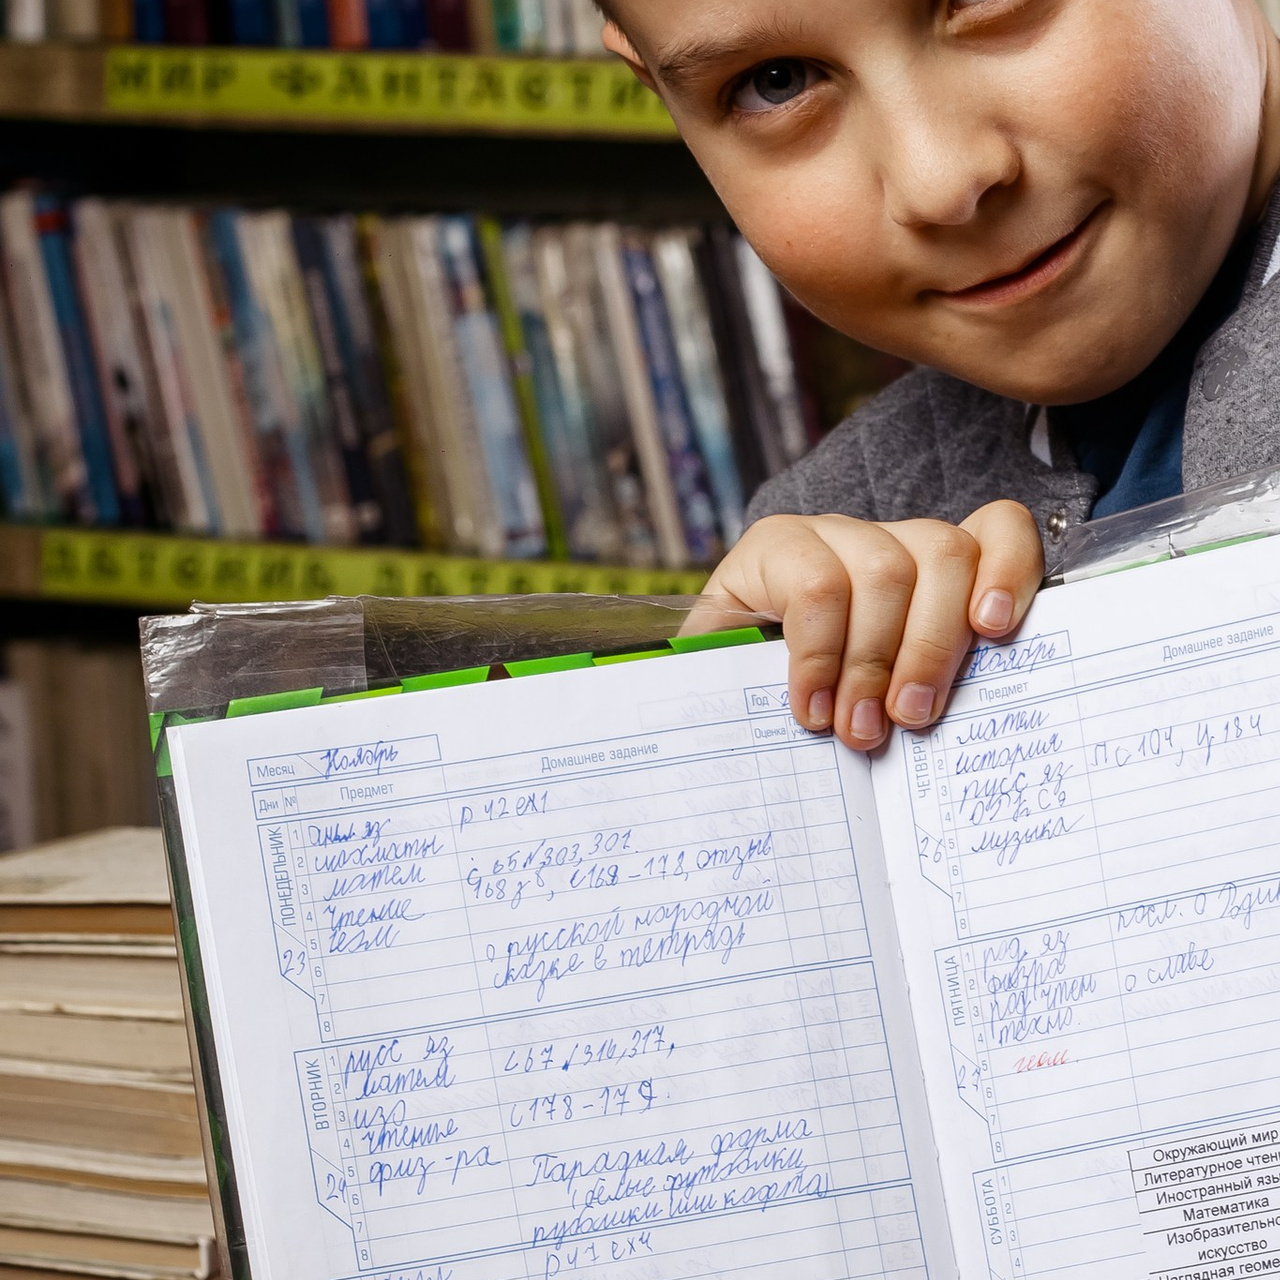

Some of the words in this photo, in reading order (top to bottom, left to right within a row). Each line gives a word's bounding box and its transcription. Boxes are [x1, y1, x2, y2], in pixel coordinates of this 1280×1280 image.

[1162, 637, 1223, 662] Домашнее
[1226, 624, 1275, 645] задание
[751, 694, 769, 707] Год
[978, 681, 1029, 703] Предмет
[754, 727, 786, 739] Оценка
[257, 763, 295, 779] Месяц
[320, 741, 399, 779] Ноябрь
[541, 750, 606, 773] Домашнее
[609, 742, 659, 760] задание
[911, 738, 931, 798] ЧЕТВЕРГ
[285, 794, 297, 807] №
[340, 783, 394, 801] Предмет
[259, 800, 279, 815] Дни
[919, 837, 943, 863] 26
[267, 826, 297, 926] ПОНЕДЕЛЬНИК
[283, 949, 306, 976] 23
[944, 955, 966, 1026] ПЯТНИЦА
[305, 1058, 330, 1131] ВТОРНИК
[1152, 1133, 1247, 1164] Окружающий
[1251, 1128, 1279, 1147] мир
[1143, 1157, 1243, 1186] Литературное
[326, 1174, 347, 1203] 24
[1155, 1176, 1253, 1206] Иностранный
[982, 1178, 1003, 1246] СУББОТА
[1182, 1196, 1270, 1222] Математика
[1197, 1237, 1268, 1264] искусство
